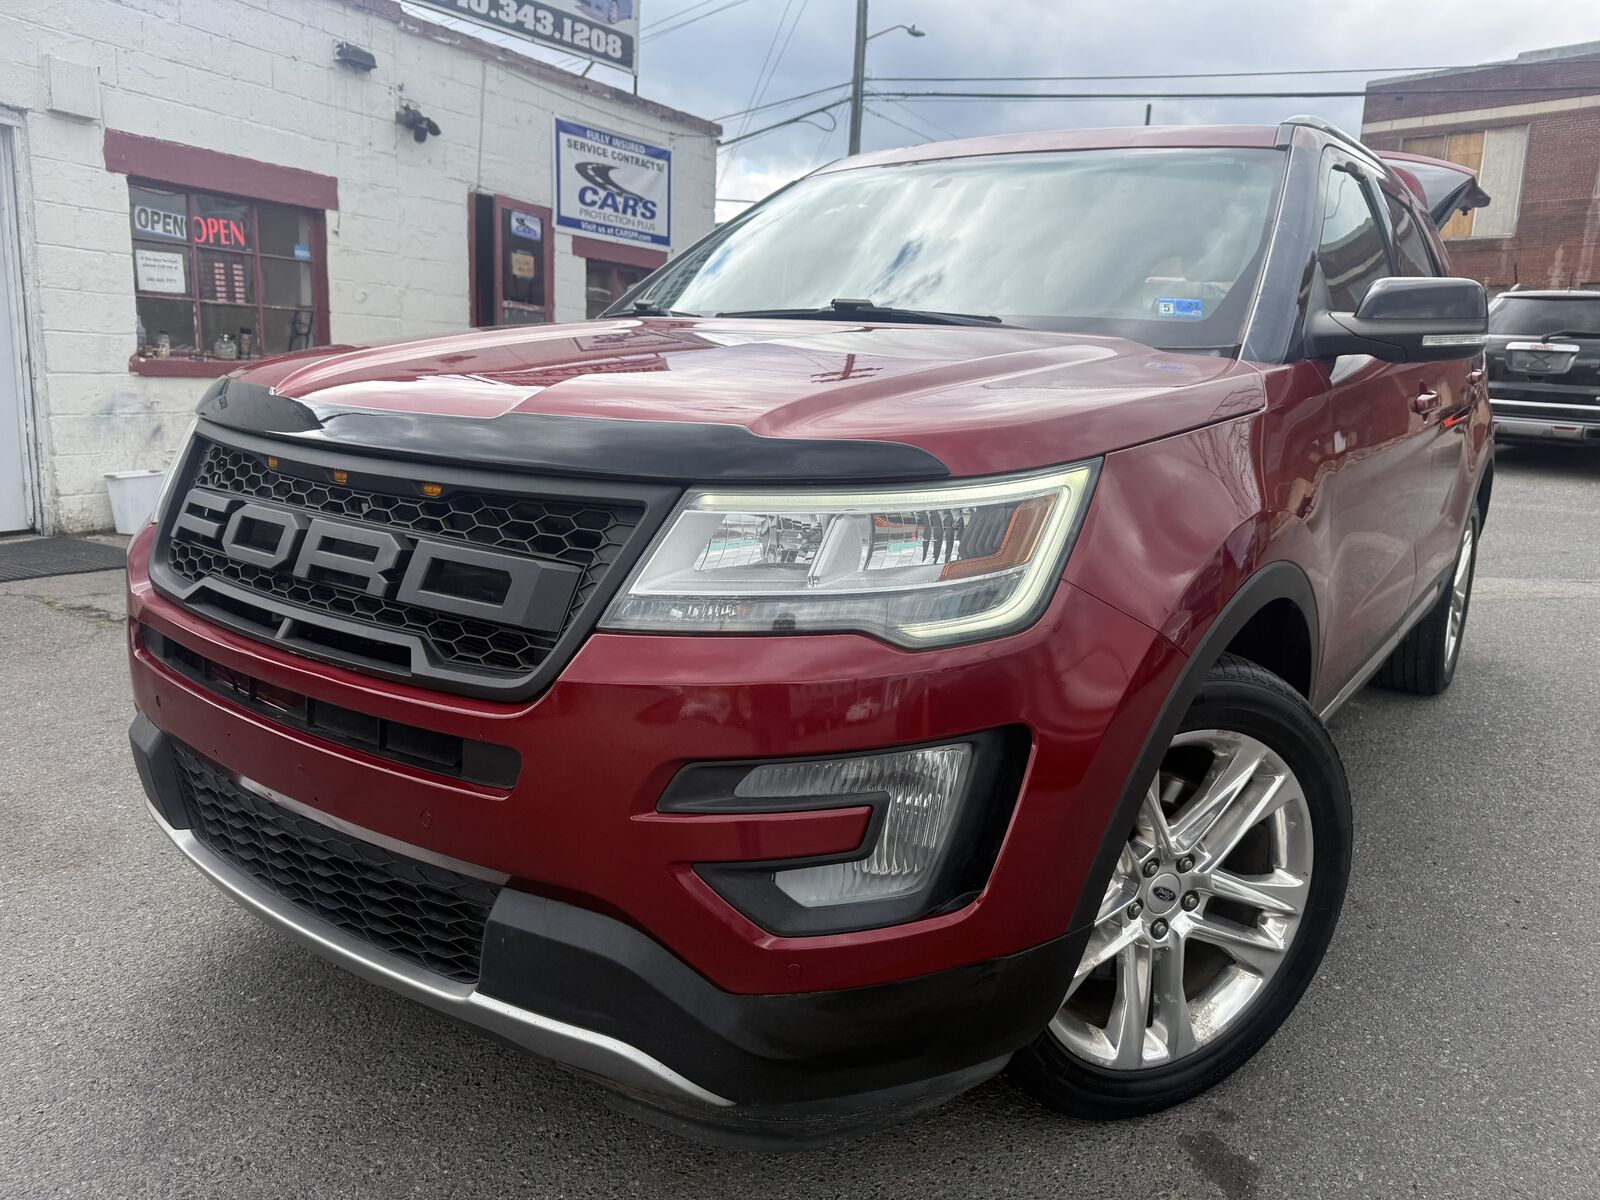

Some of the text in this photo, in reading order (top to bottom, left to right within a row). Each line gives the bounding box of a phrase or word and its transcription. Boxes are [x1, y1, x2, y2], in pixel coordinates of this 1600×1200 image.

[566, 138, 608, 158] SERVICE
[586, 130, 646, 153] FULLY INSURED
[136, 207, 185, 238] OPEN
[579, 208, 656, 231] PROTECTION PLUS
[581, 221, 597, 231] Visit
[193, 216, 246, 247] OPEN
[1163, 304, 1171, 312] 5
[171, 487, 583, 633] FORD
